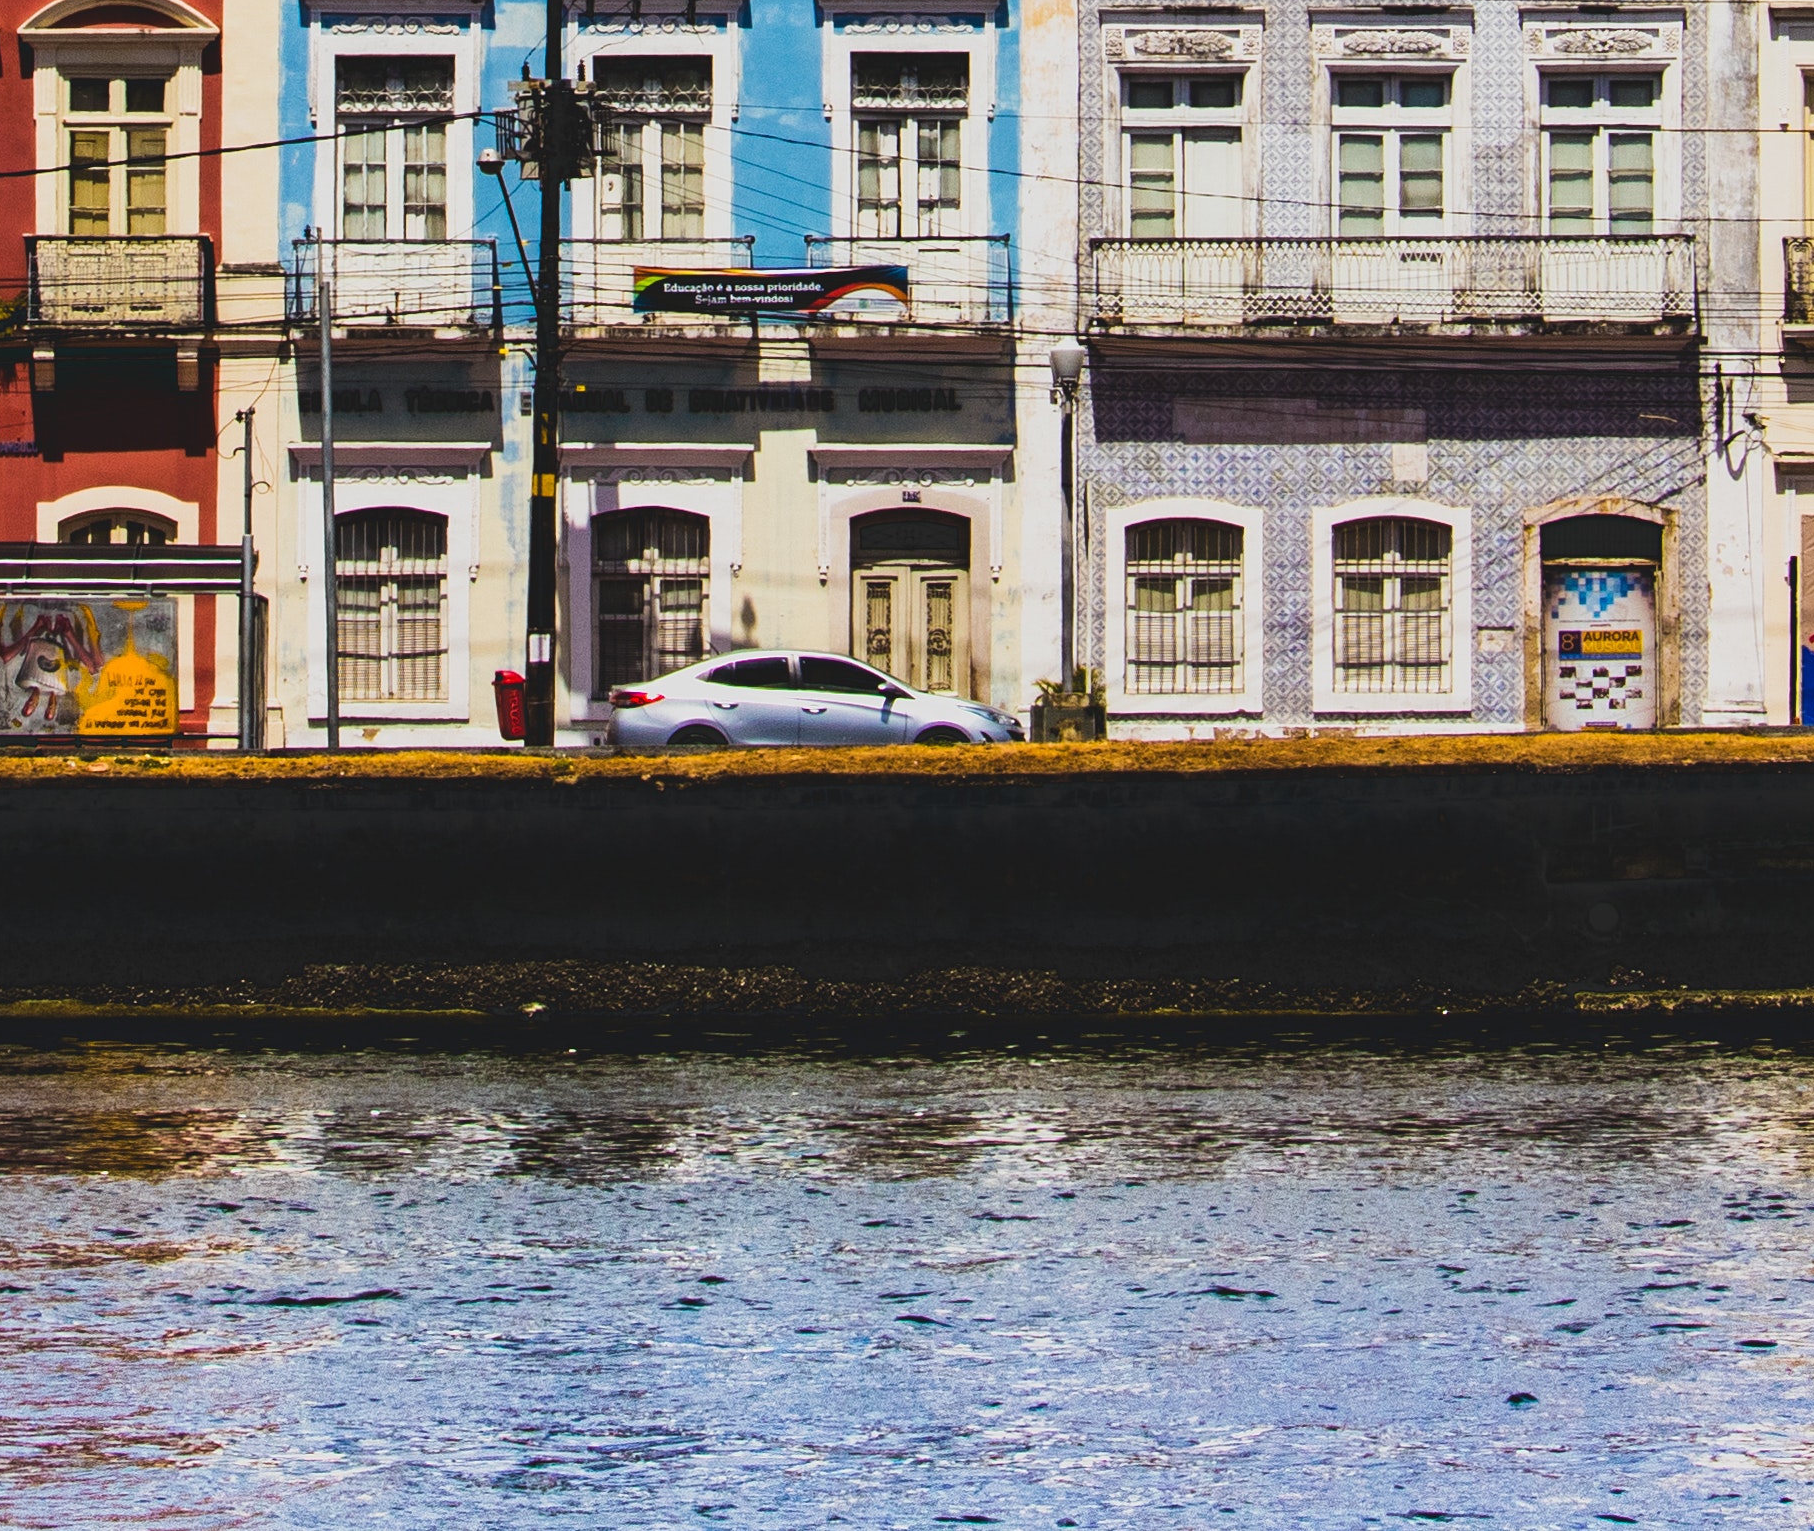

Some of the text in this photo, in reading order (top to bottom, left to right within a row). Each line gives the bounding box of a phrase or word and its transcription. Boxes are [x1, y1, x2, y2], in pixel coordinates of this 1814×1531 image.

[663, 282, 714, 293] Educação
[767, 282, 824, 293] prioridade.
[1584, 631, 1639, 641] AURORA
[1584, 641, 1640, 651] MUSICAL
